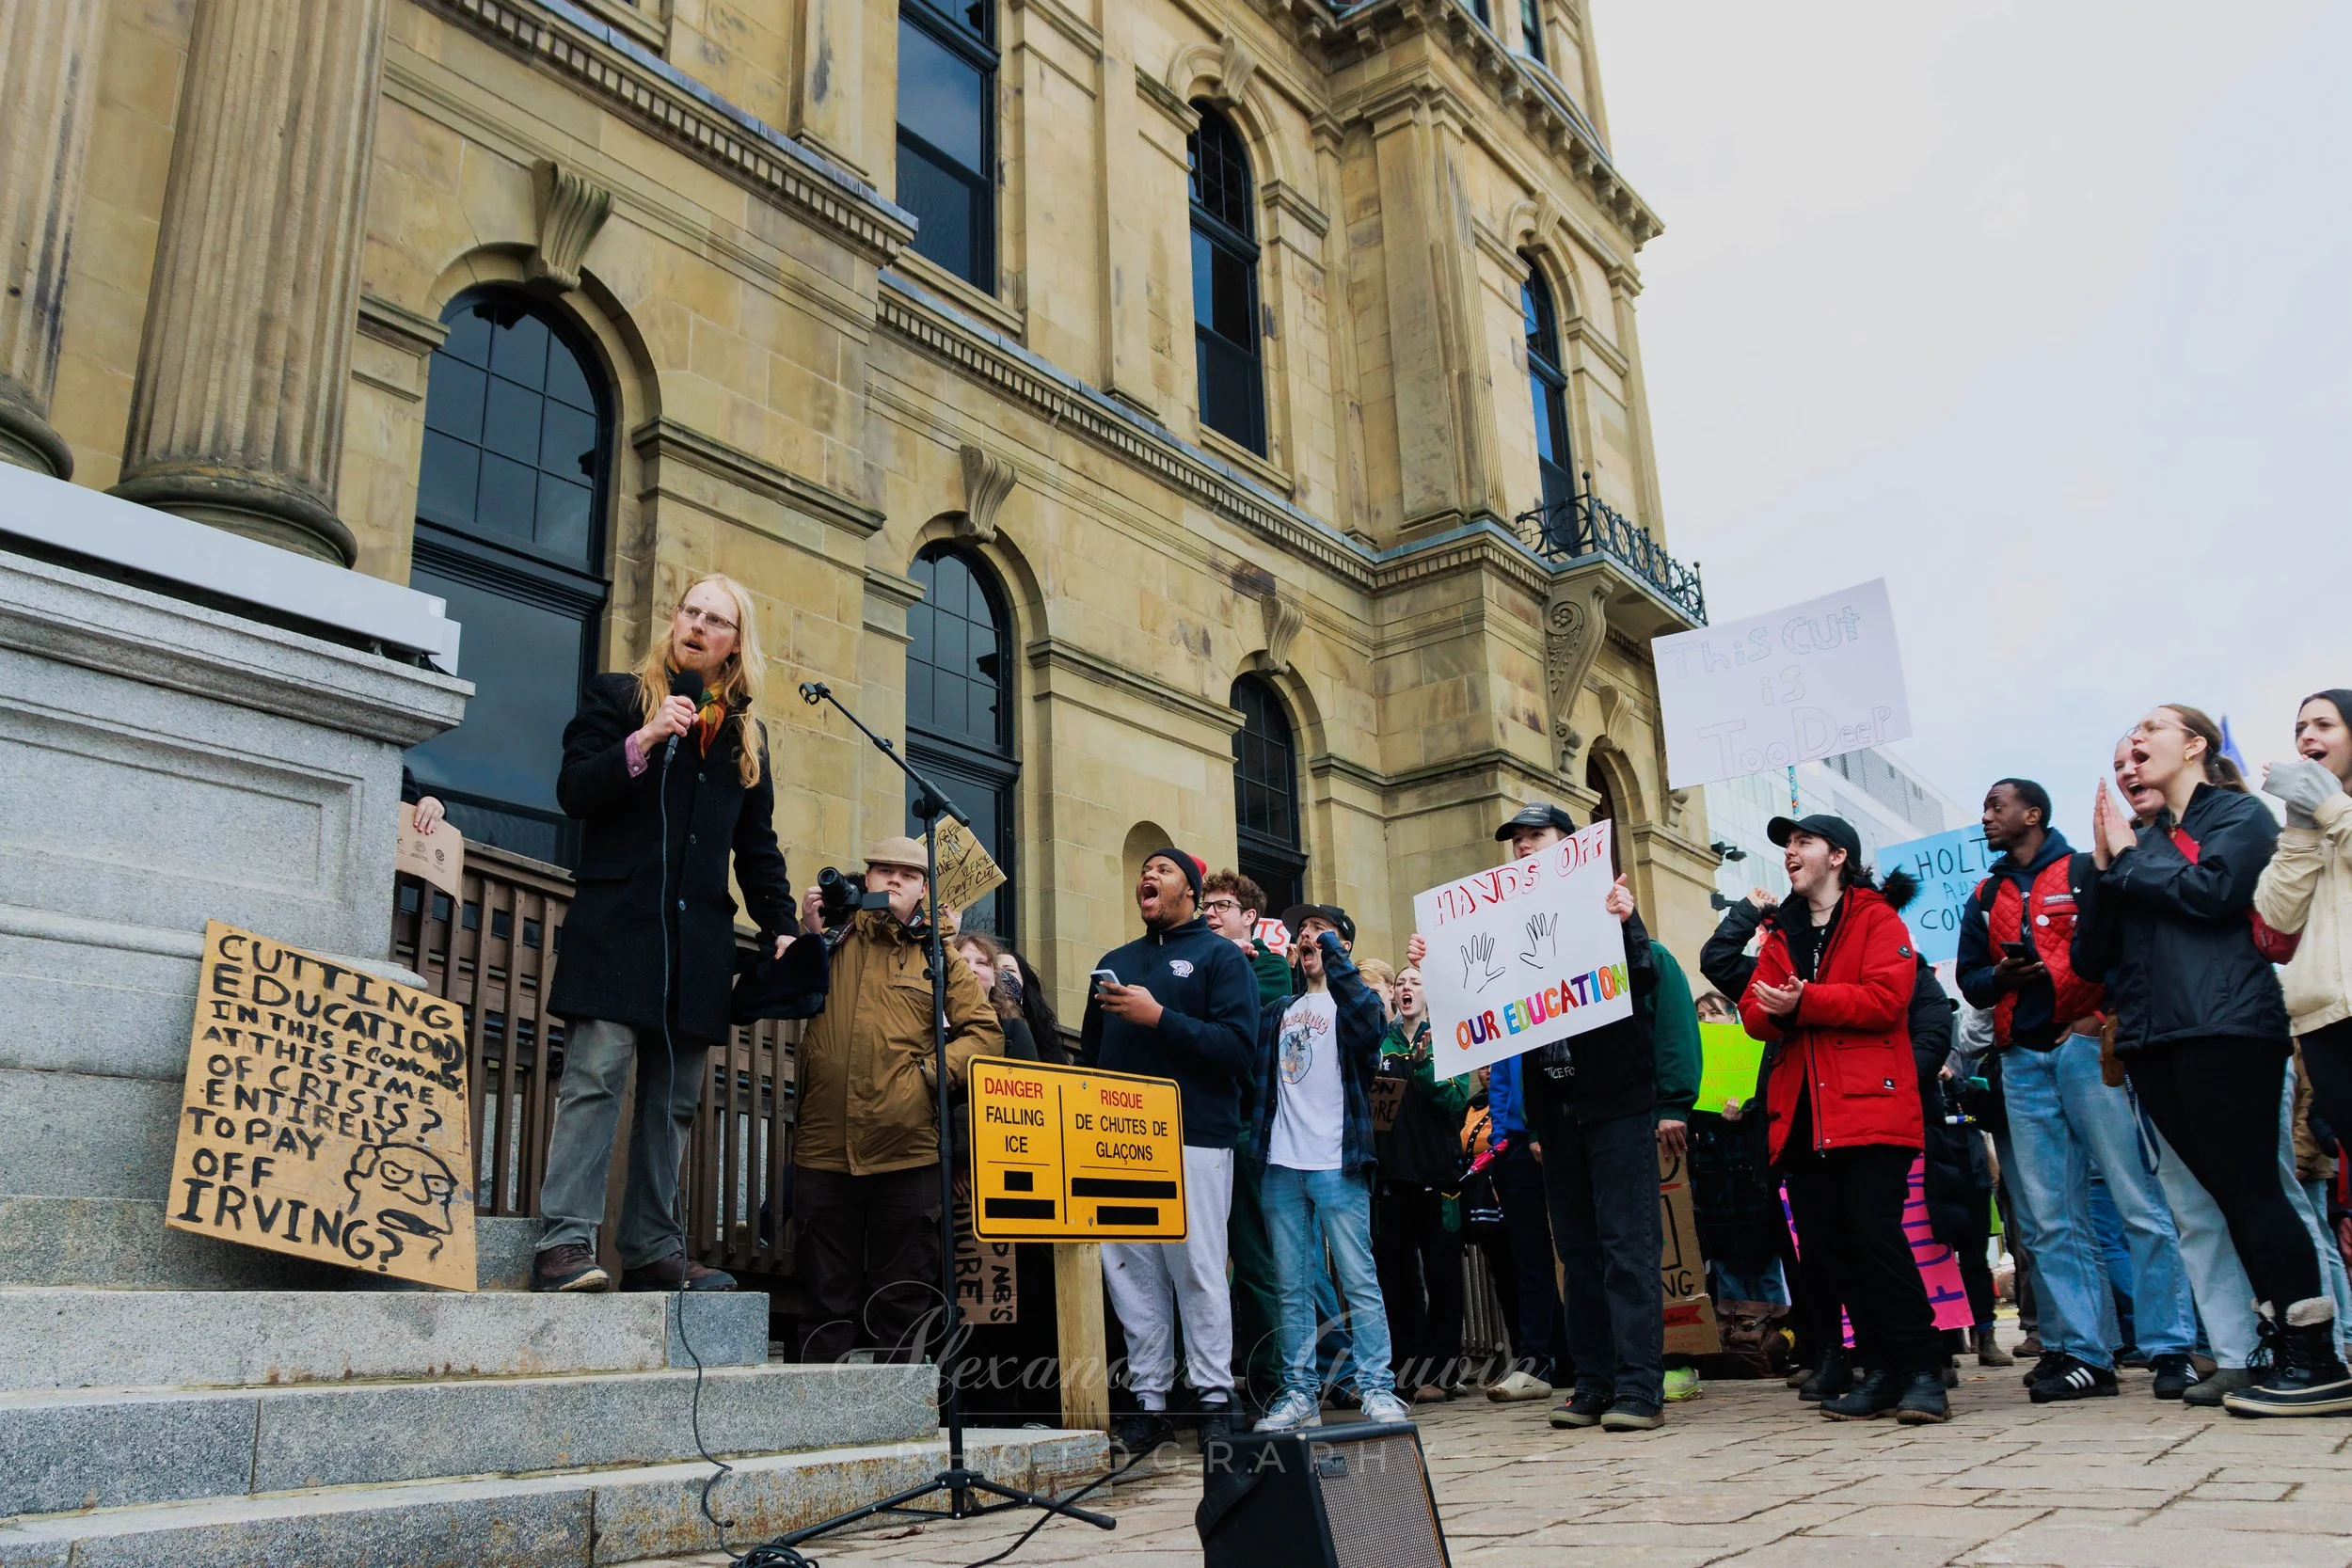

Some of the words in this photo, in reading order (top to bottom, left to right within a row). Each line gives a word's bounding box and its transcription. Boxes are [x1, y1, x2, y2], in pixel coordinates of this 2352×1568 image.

[961, 853, 993, 879] PLEASE
[976, 864, 996, 884] CUT
[1433, 858, 1543, 927] HANDS
[1555, 821, 1607, 878] OFF
[1915, 836, 1988, 881] HOLT
[1258, 920, 1286, 947] TS
[218, 934, 453, 1030] CUTTING
[209, 1000, 260, 1023] IN
[268, 1012, 335, 1050] THIS
[213, 962, 454, 1062] EDUCATION
[1455, 1009, 1502, 1051] OUR
[1502, 960, 1629, 1036] EDUCATION
[202, 1025, 243, 1049] AT
[247, 1032, 336, 1073] THIS
[342, 1058, 436, 1106] TIME
[205, 1078, 400, 1144] ENTIRELY
[207, 1053, 254, 1082] OF
[269, 1065, 443, 1144] CRISIS?
[984, 1077, 1043, 1100] DANGER
[1100, 1088, 1143, 1110] RISQUE
[185, 1106, 236, 1140] TO
[245, 1118, 326, 1162] PAY
[985, 1105, 1044, 1127] FALLING
[1075, 1113, 1093, 1131] DE
[1100, 1115, 1147, 1136] CHUTES
[1152, 1120, 1168, 1137] DE
[1005, 1134, 1028, 1153] ICE
[1096, 1140, 1153, 1165] GLAÇONS
[192, 1148, 277, 1189] OFF
[176, 1177, 405, 1272] IRVING?
